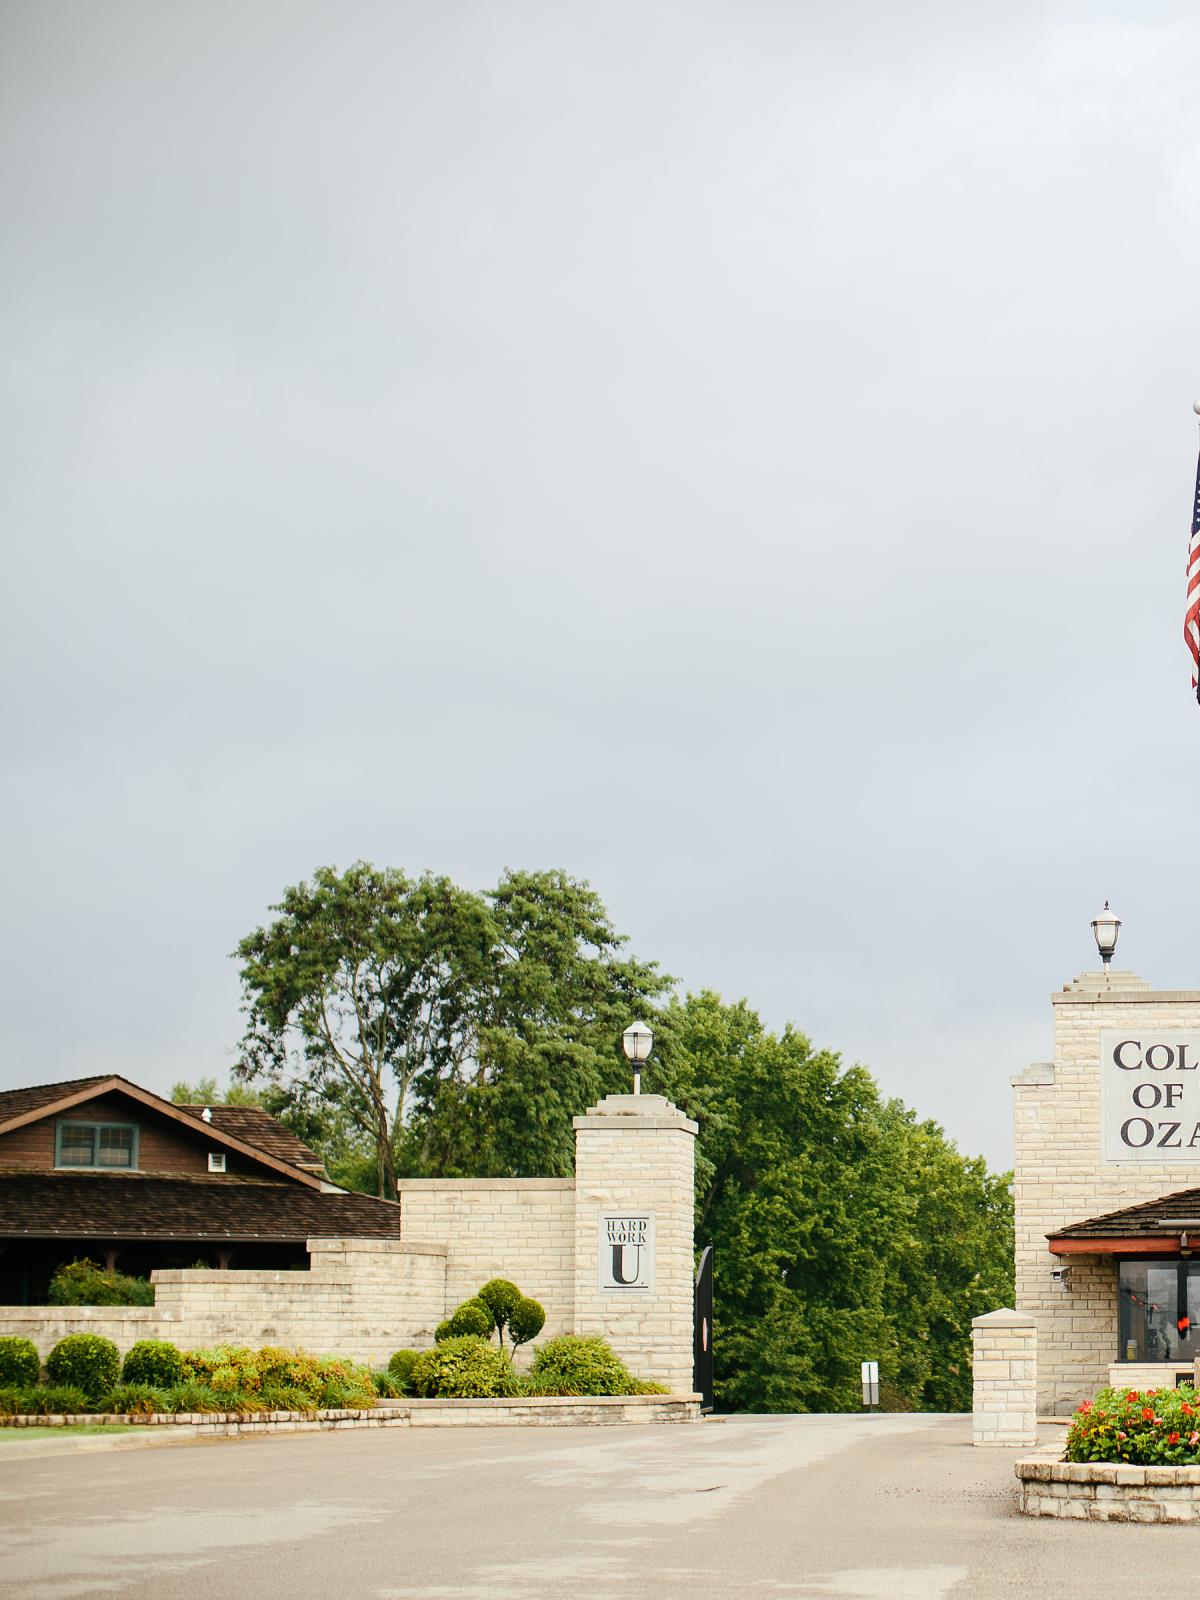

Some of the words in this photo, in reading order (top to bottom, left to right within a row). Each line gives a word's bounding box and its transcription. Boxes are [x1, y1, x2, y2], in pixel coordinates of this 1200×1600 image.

[1132, 1083, 1184, 1109] OF
[606, 1220, 647, 1232] HARD
[606, 1232, 647, 1243] WORK
